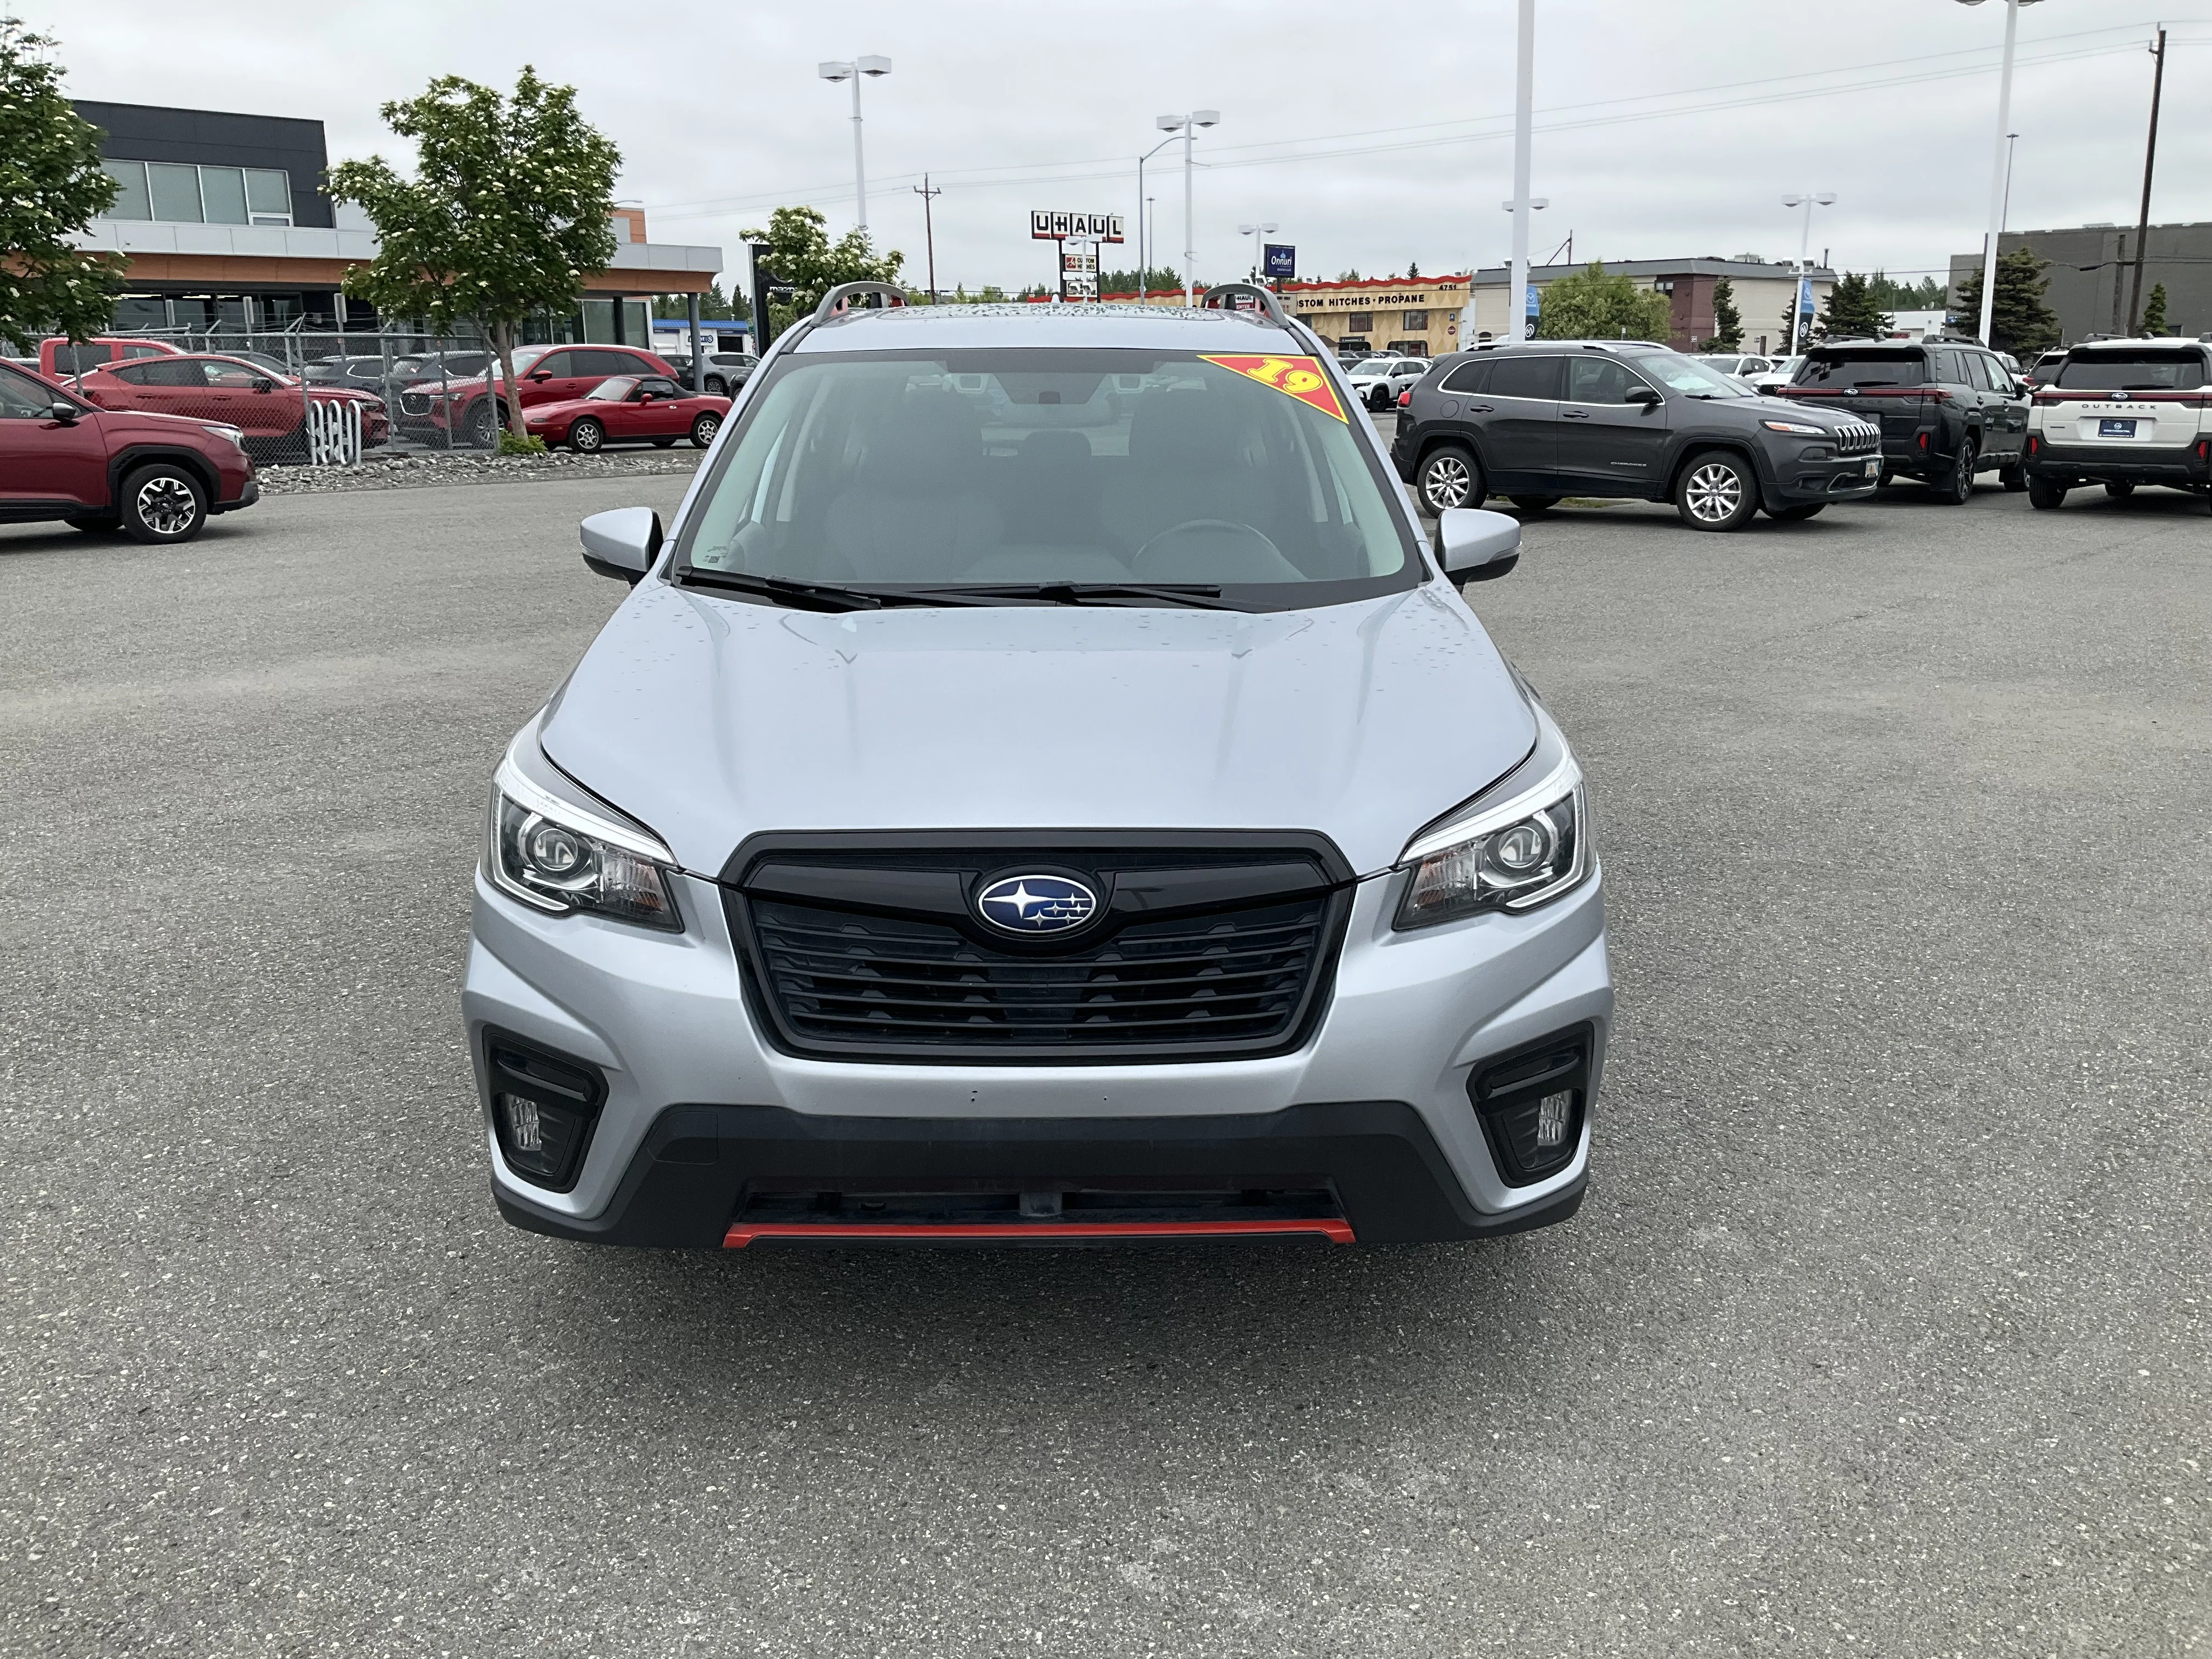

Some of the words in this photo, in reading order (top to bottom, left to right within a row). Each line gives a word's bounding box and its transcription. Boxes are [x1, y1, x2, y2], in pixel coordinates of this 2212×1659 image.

[1271, 256, 1292, 266] Onnuri
[1297, 299, 1323, 307] STOM
[1329, 297, 1370, 306] HITCHES
[1378, 295, 1425, 304] PROPANE
[1246, 358, 1323, 394] 19
